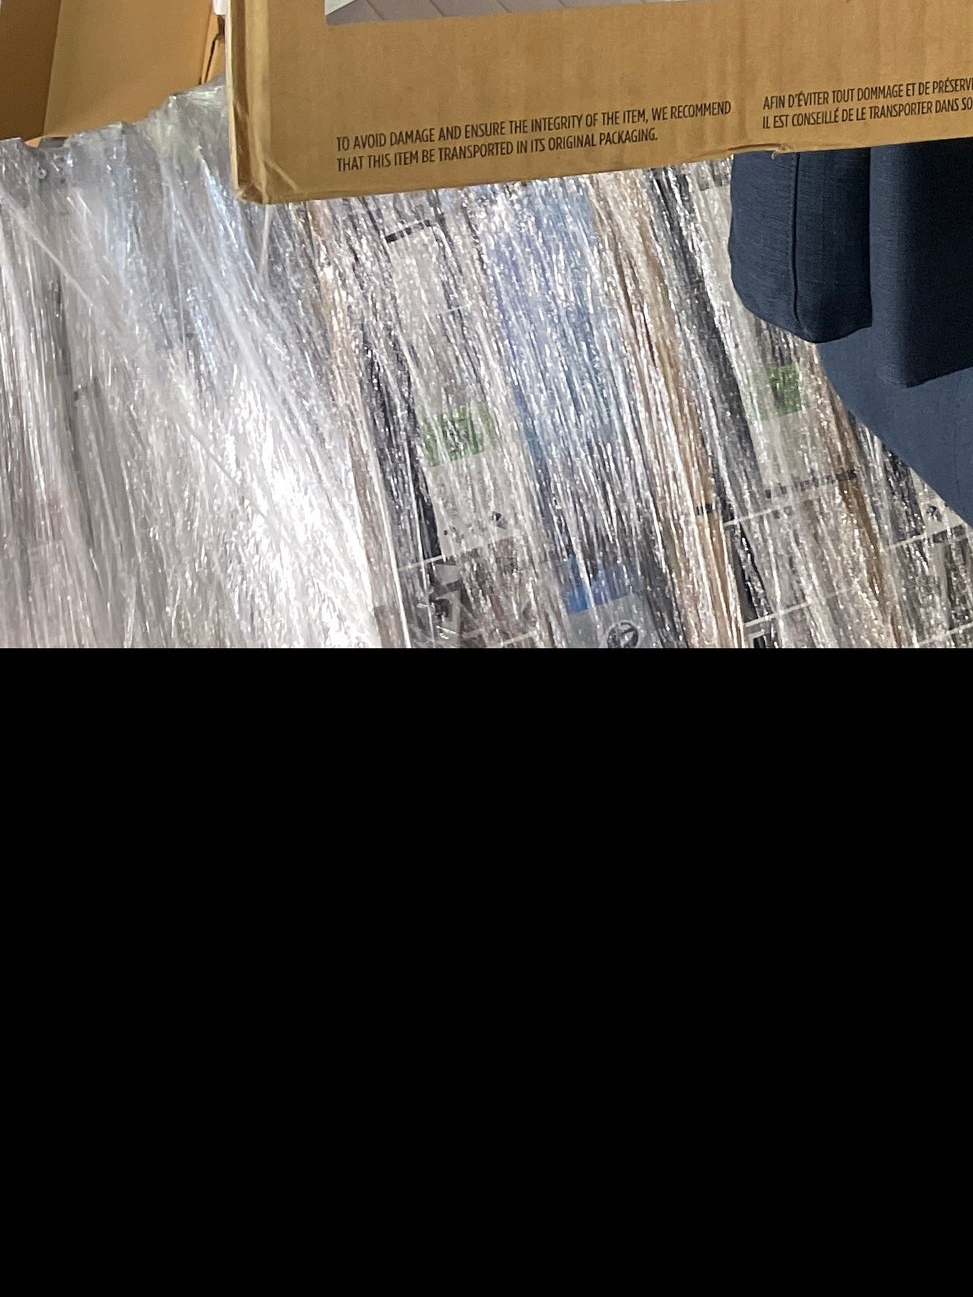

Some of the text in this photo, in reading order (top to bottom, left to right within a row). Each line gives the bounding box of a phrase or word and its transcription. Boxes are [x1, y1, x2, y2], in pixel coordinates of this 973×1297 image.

[763, 94, 785, 110] AFIN
[788, 91, 829, 107] D'ÉVITER
[832, 88, 854, 103] TOUT
[857, 83, 903, 101] DOMMAGE
[906, 82, 916, 96] ET
[918, 81, 929, 95] DE
[337, 101, 731, 151] TO AVOID DAMAGE AND ENSURE THE INTEGRITY OF THE ITEM, WE RECOMMEND
[338, 127, 657, 171] THAT THIS ITEM BE TRANSPORTED IN ITS ORIGINAL PACKAGING.
